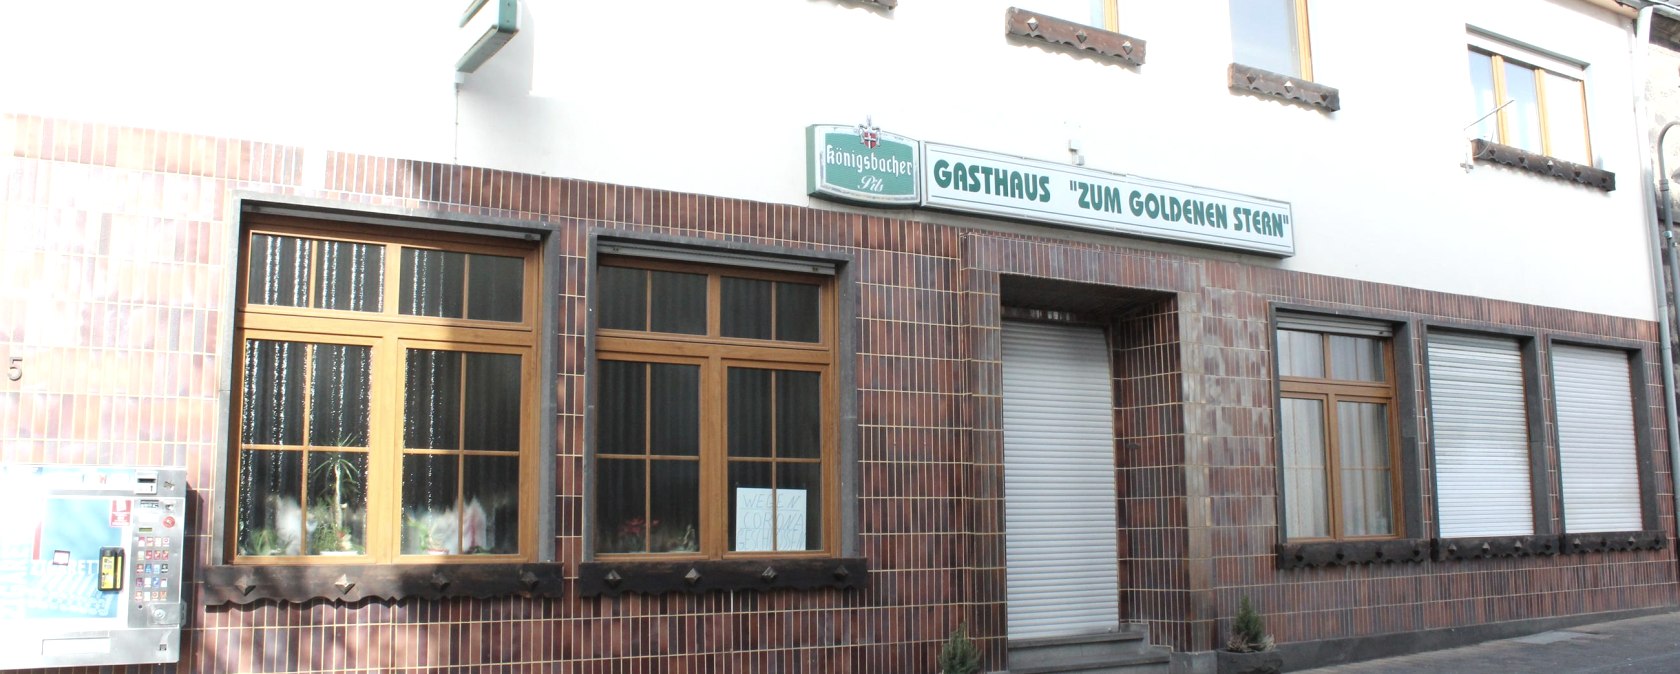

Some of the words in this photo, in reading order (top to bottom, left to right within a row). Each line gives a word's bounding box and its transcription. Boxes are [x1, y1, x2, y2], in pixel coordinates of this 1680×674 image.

[857, 175, 884, 192] Pils
[933, 159, 1051, 203] GASTHAUS
[1069, 179, 1122, 214] "ZUM
[1128, 190, 1228, 229] GOLDENEN
[1233, 206, 1290, 238] STERN"
[7, 356, 23, 381] 5
